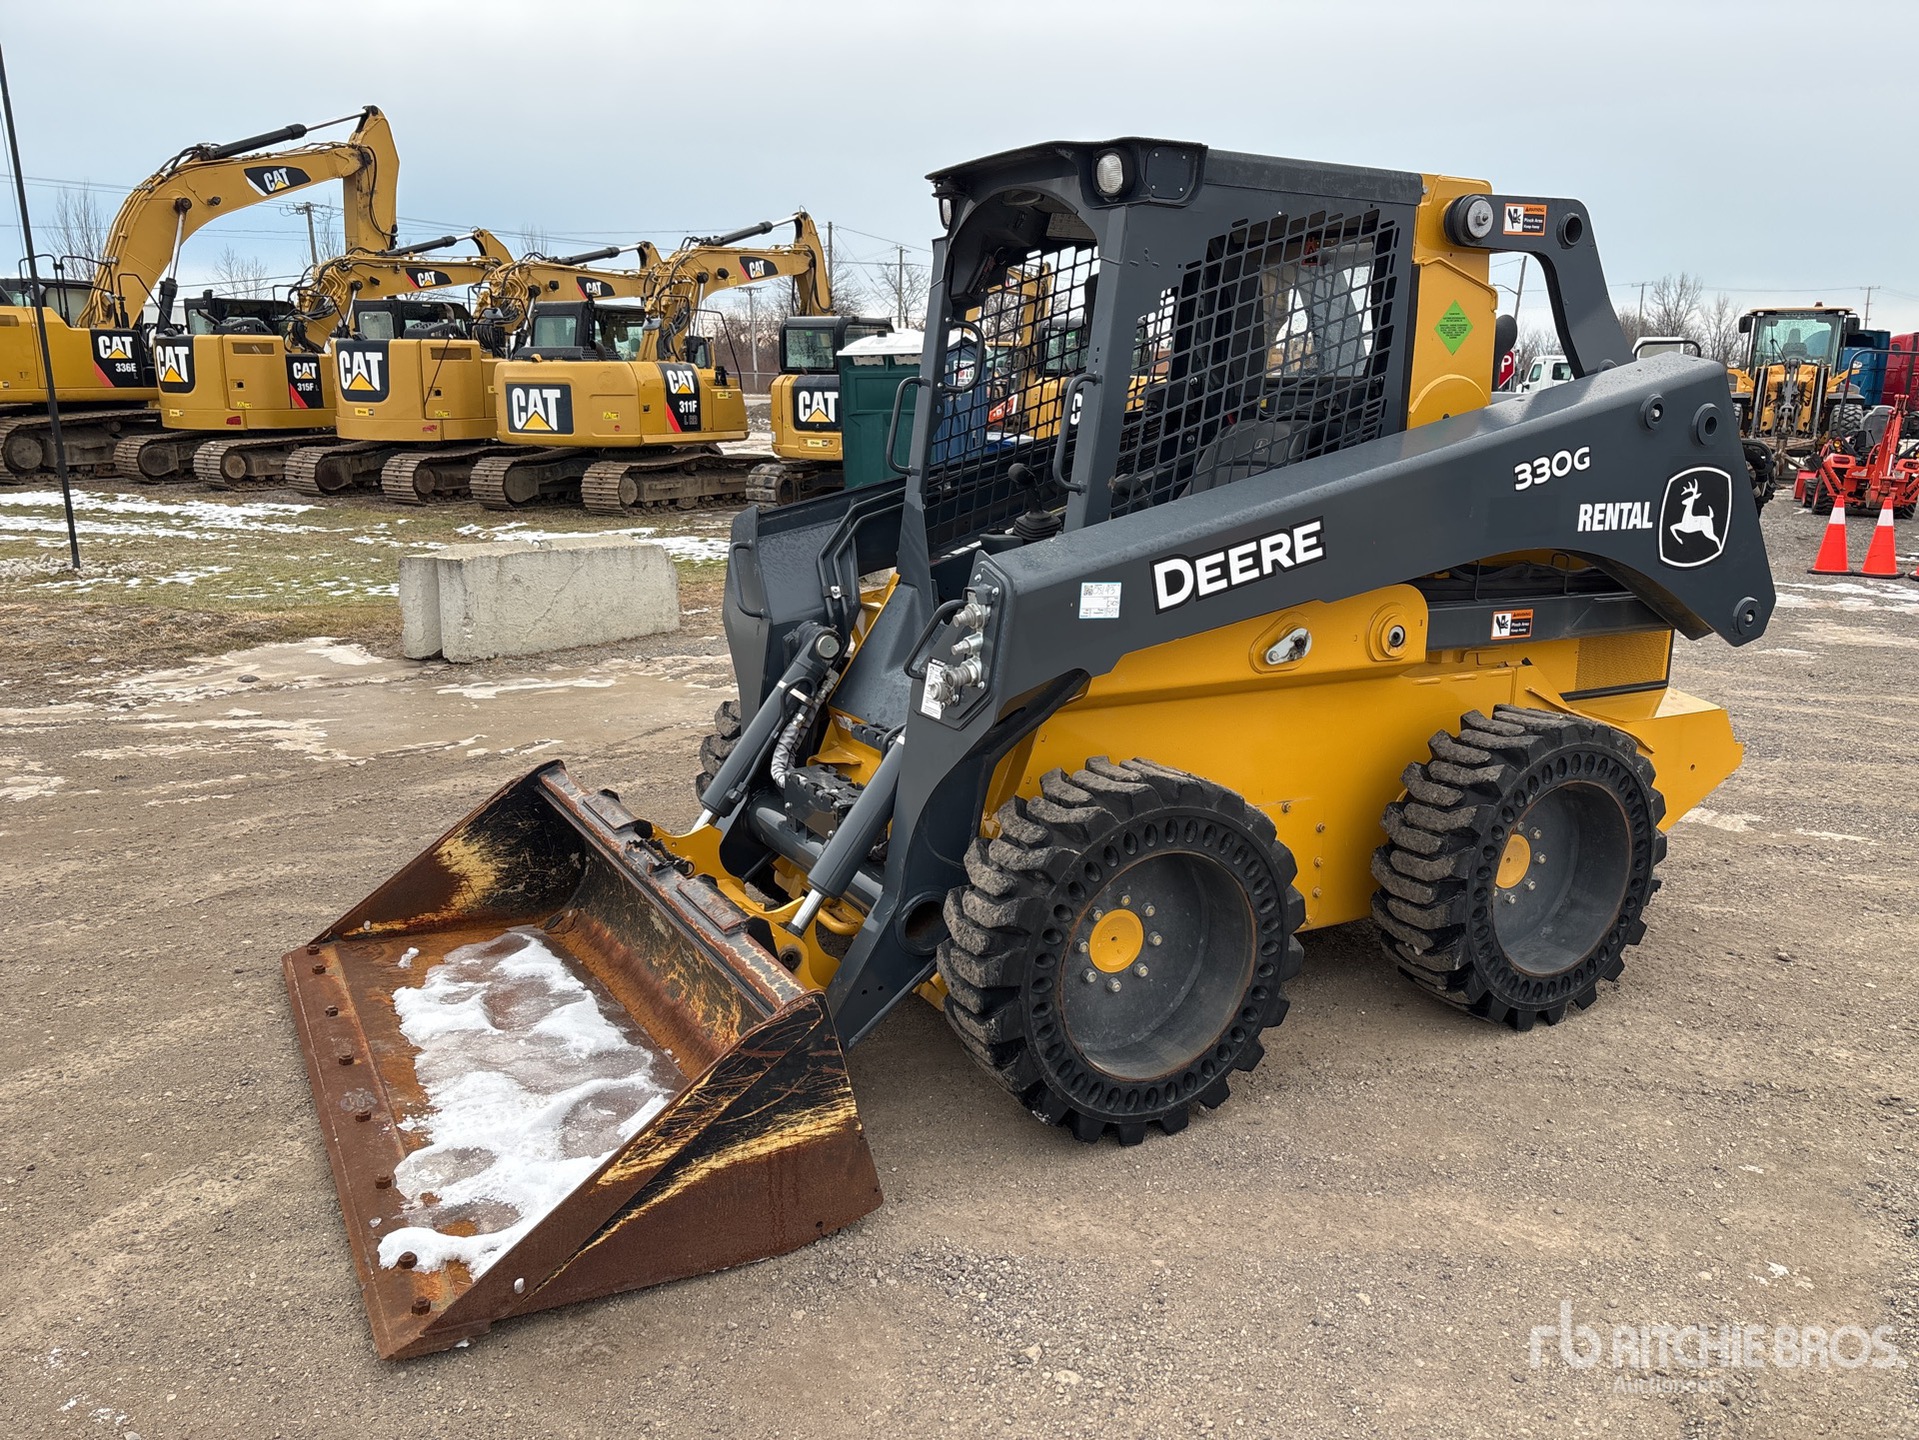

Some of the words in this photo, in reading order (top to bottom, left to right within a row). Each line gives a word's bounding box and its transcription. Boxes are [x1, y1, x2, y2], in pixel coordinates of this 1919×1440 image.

[263, 167, 290, 191] CAT
[417, 271, 436, 287] CAT
[749, 260, 765, 278] CAT
[586, 281, 601, 296] CAT
[98, 335, 133, 359] CAT
[115, 363, 137, 372] 336E
[156, 345, 189, 383] CAT
[293, 362, 317, 379] CAT
[339, 350, 383, 391] CAT
[297, 382, 314, 392] 315F
[666, 370, 695, 394] CAT
[512, 387, 561, 431] CAT
[679, 400, 697, 413] 311F
[798, 390, 839, 422] CAT
[1514, 446, 1591, 491] 330G
[1577, 501, 1653, 532] RENTAL
[1153, 520, 1324, 610] DEERE
